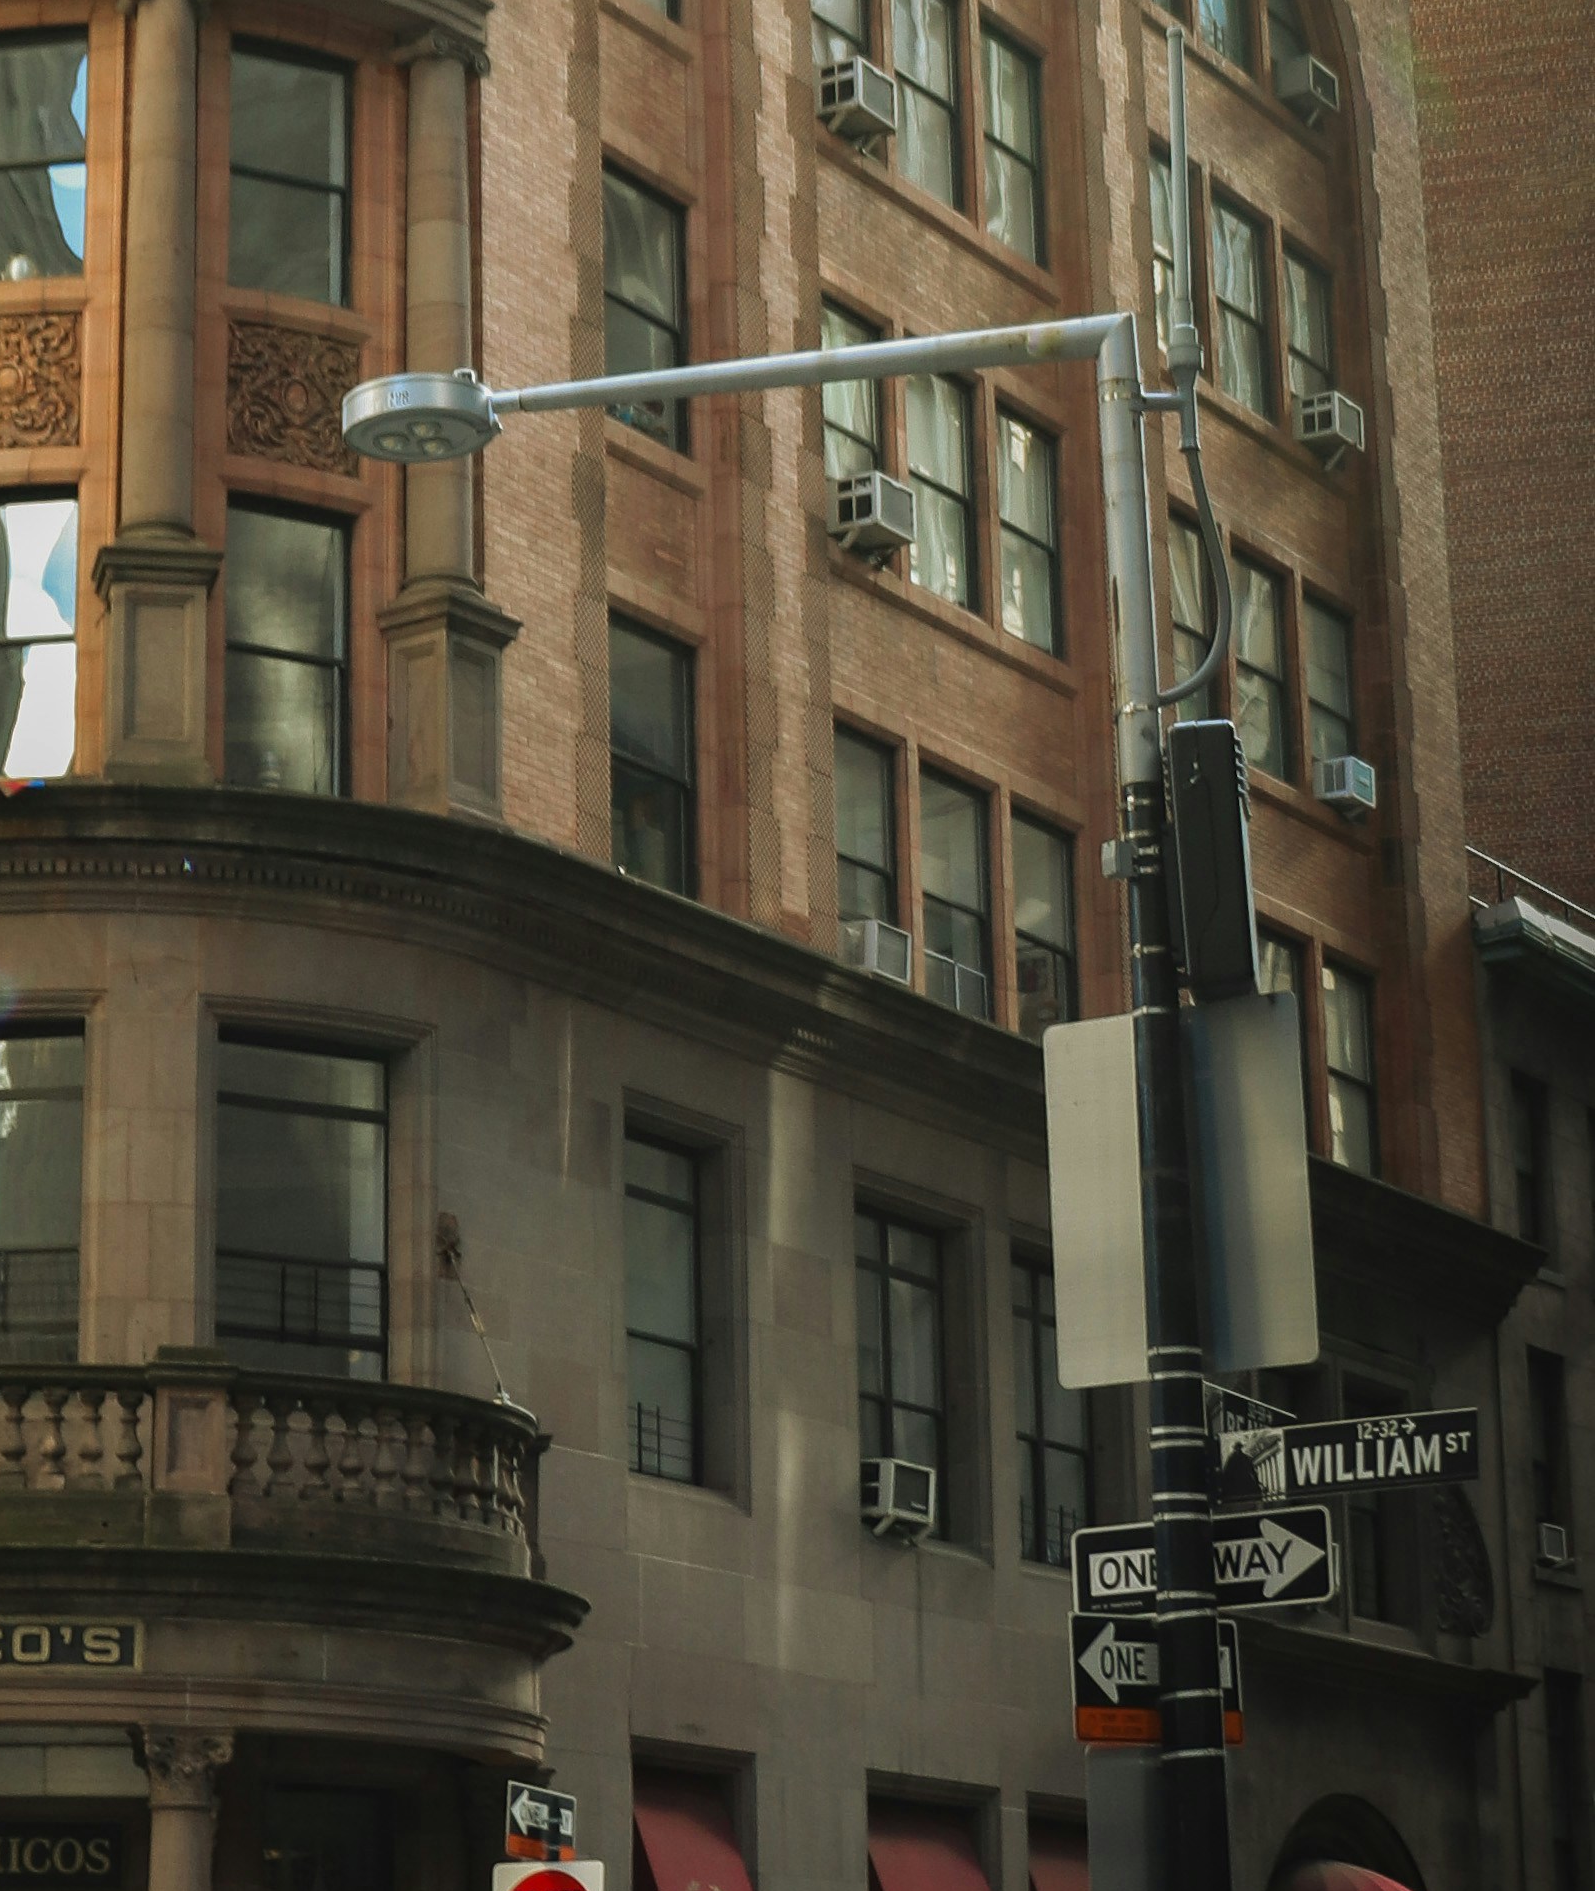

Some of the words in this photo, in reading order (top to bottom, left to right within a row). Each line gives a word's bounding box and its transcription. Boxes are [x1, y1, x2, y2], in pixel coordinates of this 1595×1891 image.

[1356, 1419, 1399, 1440] 12-32
[1291, 1433, 1441, 1486] WILLIAM
[1445, 1431, 1472, 1454] ST
[1213, 1539, 1293, 1580] WAY
[1099, 1644, 1148, 1681] ONE
